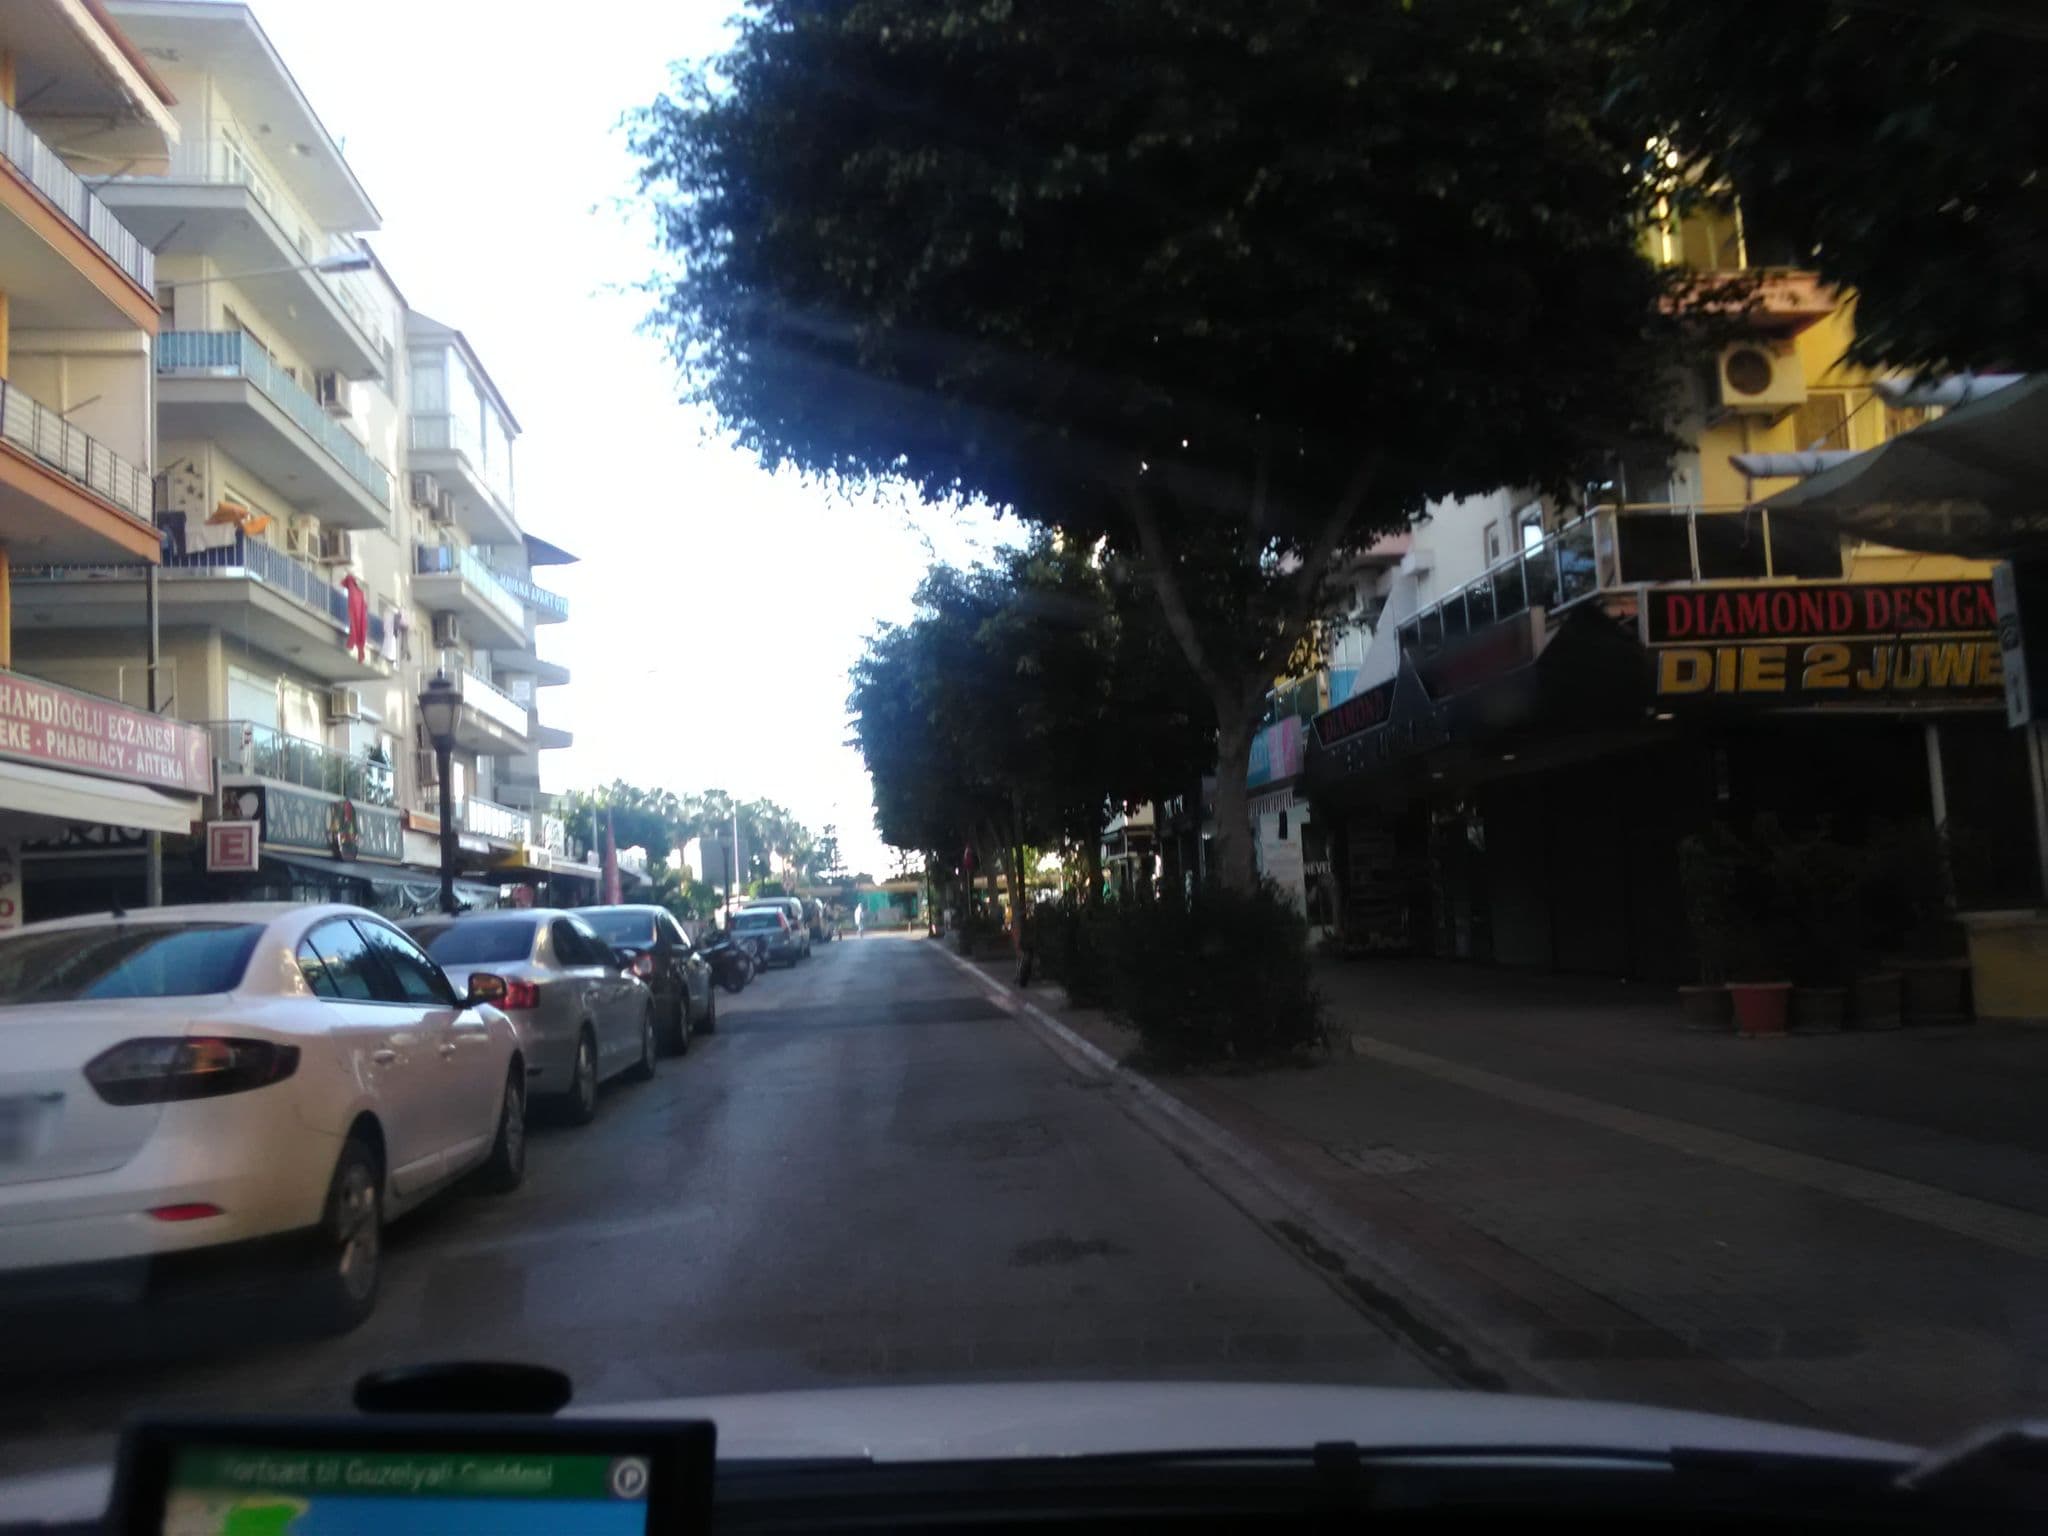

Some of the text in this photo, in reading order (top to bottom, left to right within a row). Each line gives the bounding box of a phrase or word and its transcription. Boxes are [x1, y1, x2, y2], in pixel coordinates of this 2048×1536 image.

[1666, 584, 1998, 637] DIAMOND DESIGN
[1657, 641, 2006, 695] DIE 2 JUWE
[46, 729, 125, 770] PHARMACY
[220, 833, 244, 862] E
